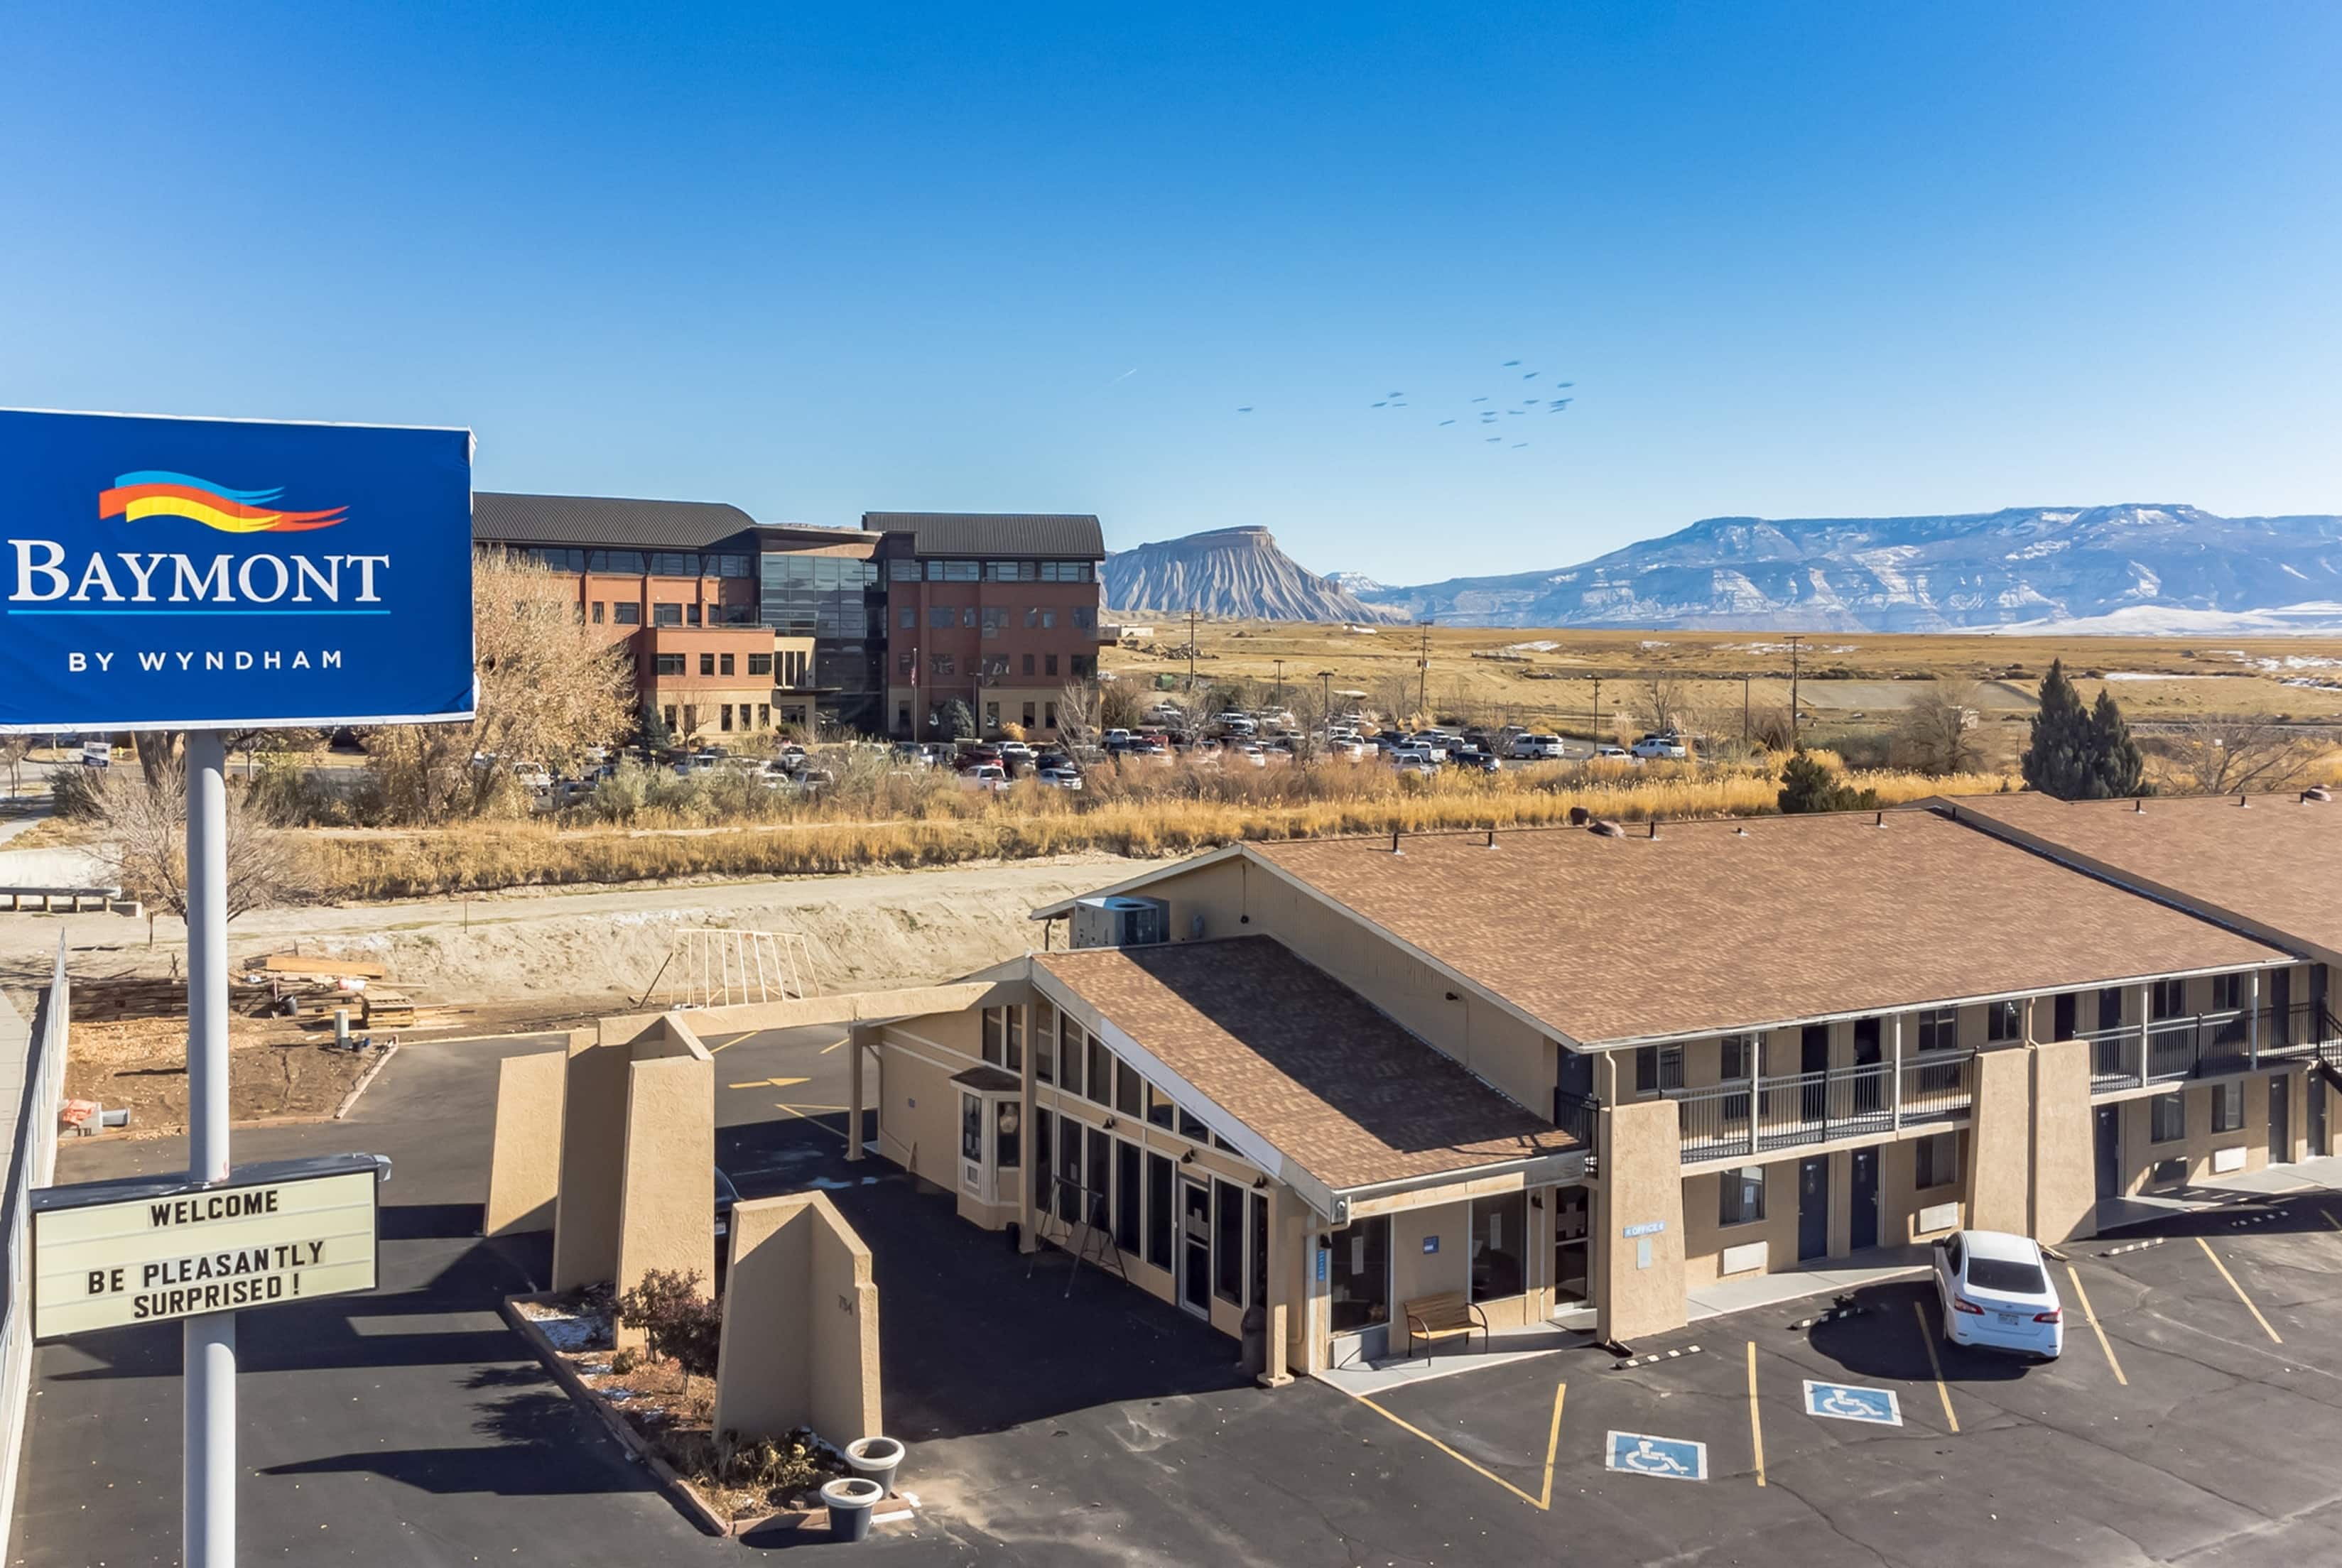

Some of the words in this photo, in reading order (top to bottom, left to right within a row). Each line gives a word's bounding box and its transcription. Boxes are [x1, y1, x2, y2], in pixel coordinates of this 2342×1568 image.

[8, 539, 390, 602] BAYMONT
[68, 653, 114, 672] BY
[139, 650, 342, 670] WYNDHAM
[151, 1190, 278, 1227] WELCOME
[88, 1269, 125, 1295] BE
[143, 1241, 324, 1287] PLEASANTLY
